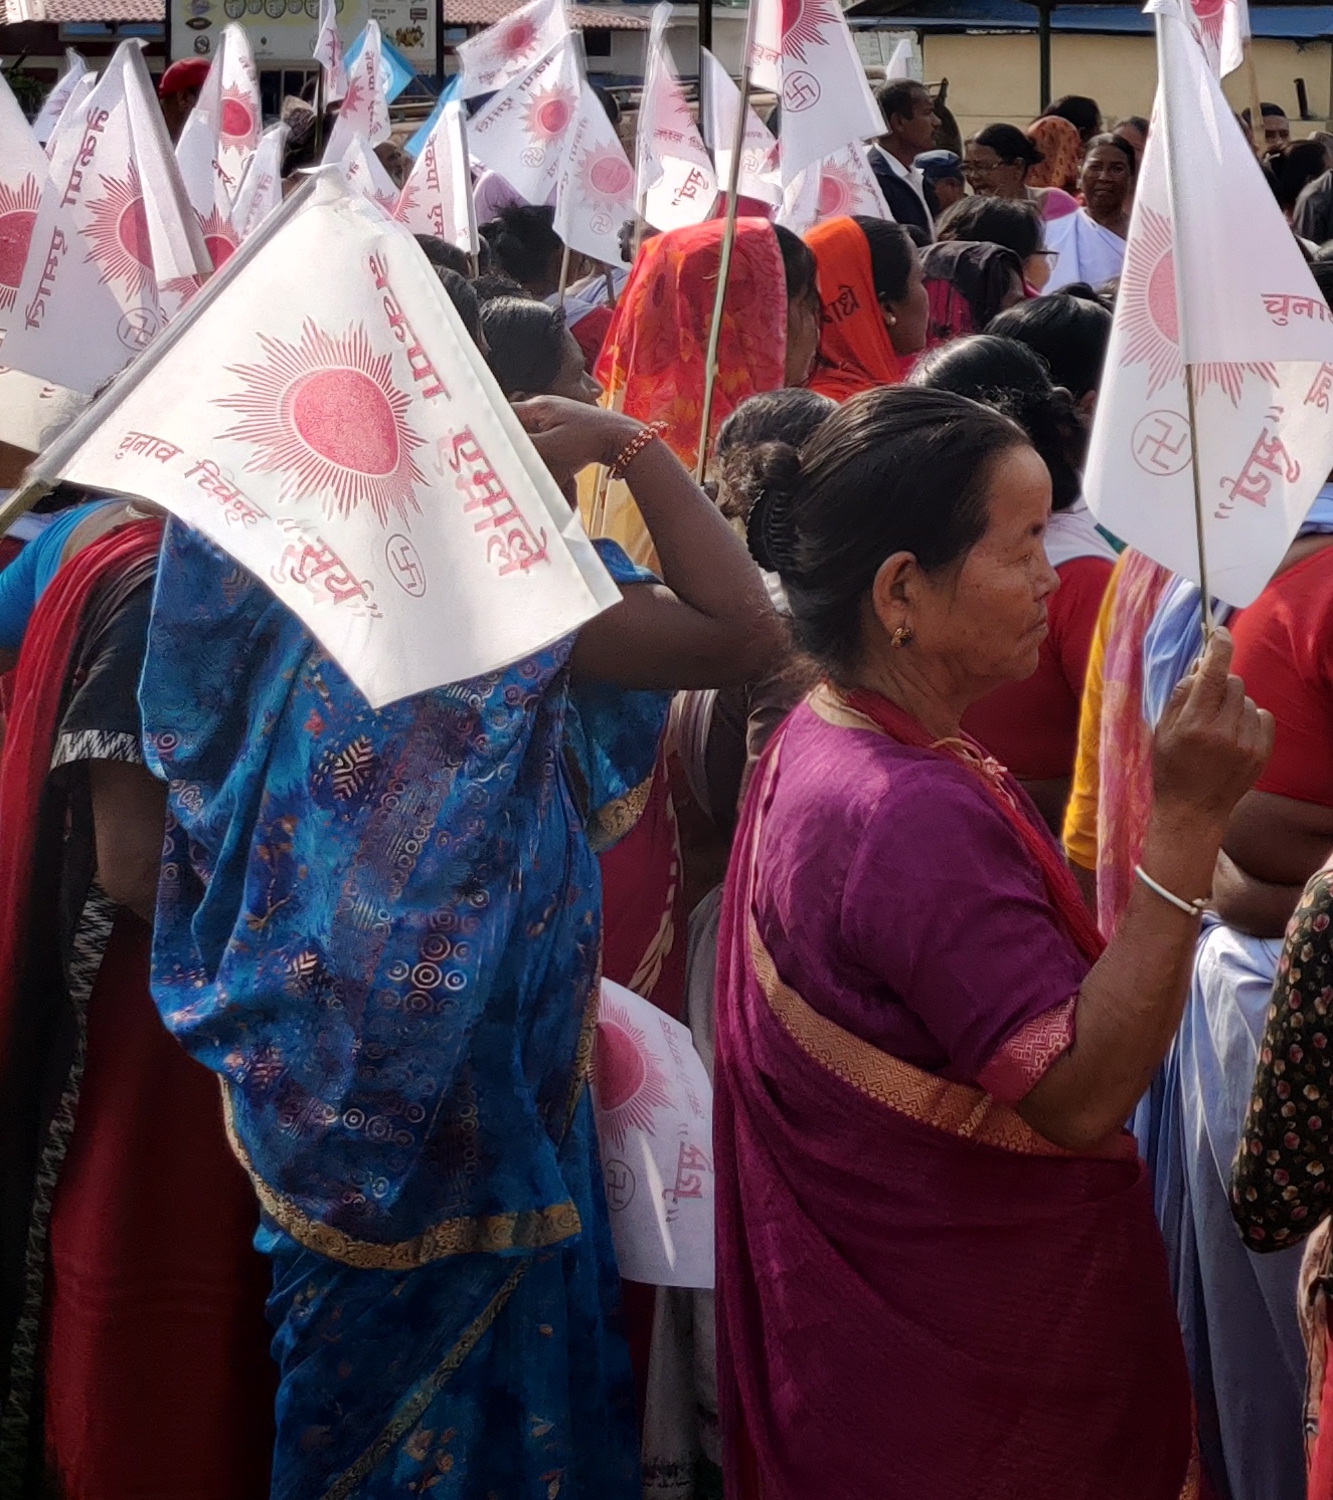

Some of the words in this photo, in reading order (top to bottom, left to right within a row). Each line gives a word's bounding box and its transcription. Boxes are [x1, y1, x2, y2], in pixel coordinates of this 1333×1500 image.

[115, 430, 185, 465] चुनाव
[367, 249, 452, 403] नेकपा
[434, 424, 551, 575] एमाले
